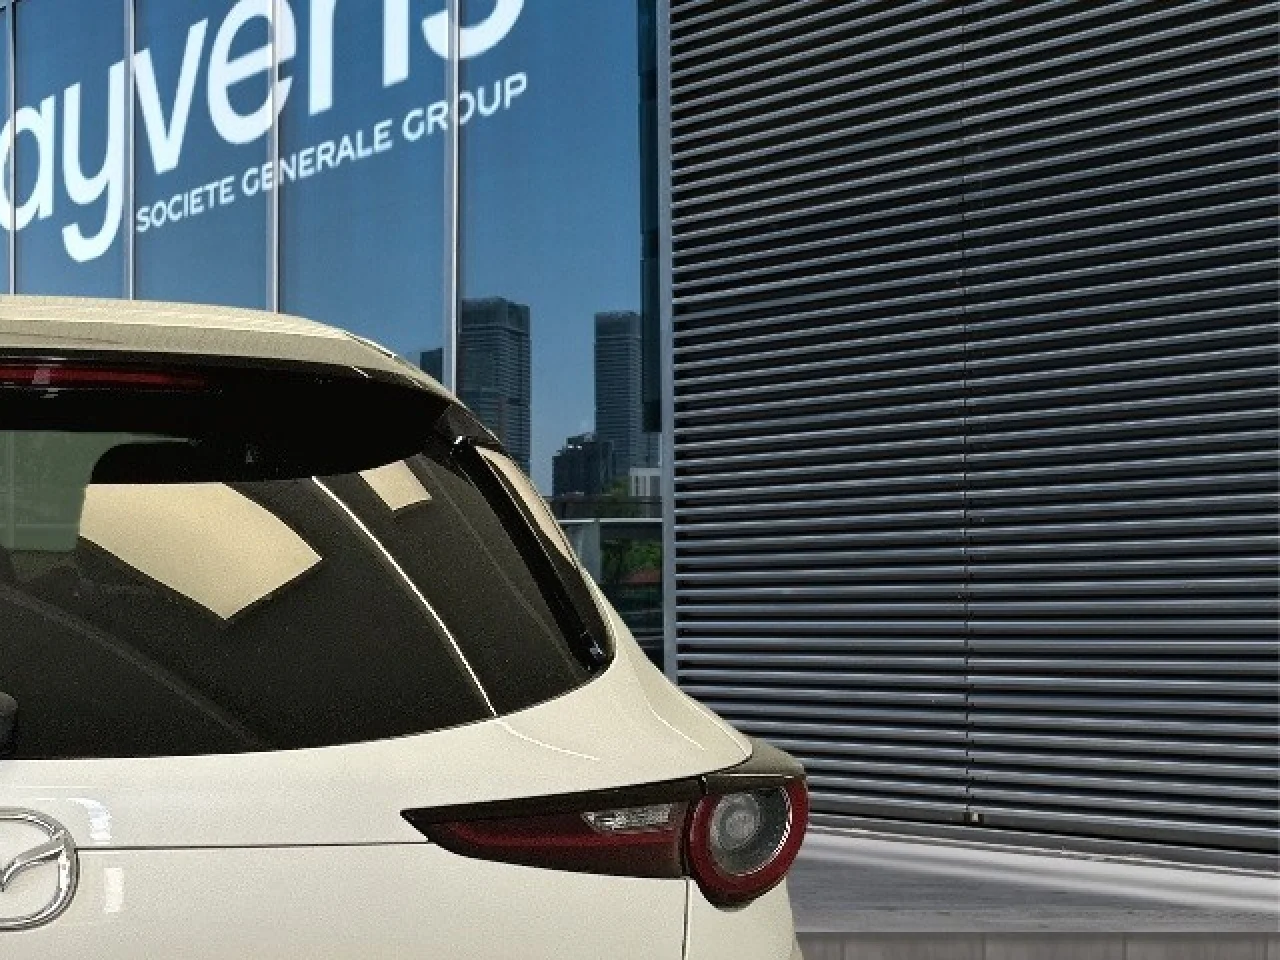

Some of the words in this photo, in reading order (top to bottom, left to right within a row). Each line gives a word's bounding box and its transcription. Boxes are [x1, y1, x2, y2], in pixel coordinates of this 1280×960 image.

[135, 175, 235, 233] SOCIETE
[241, 118, 393, 197] GENERALE
[401, 71, 527, 143] GROUP
